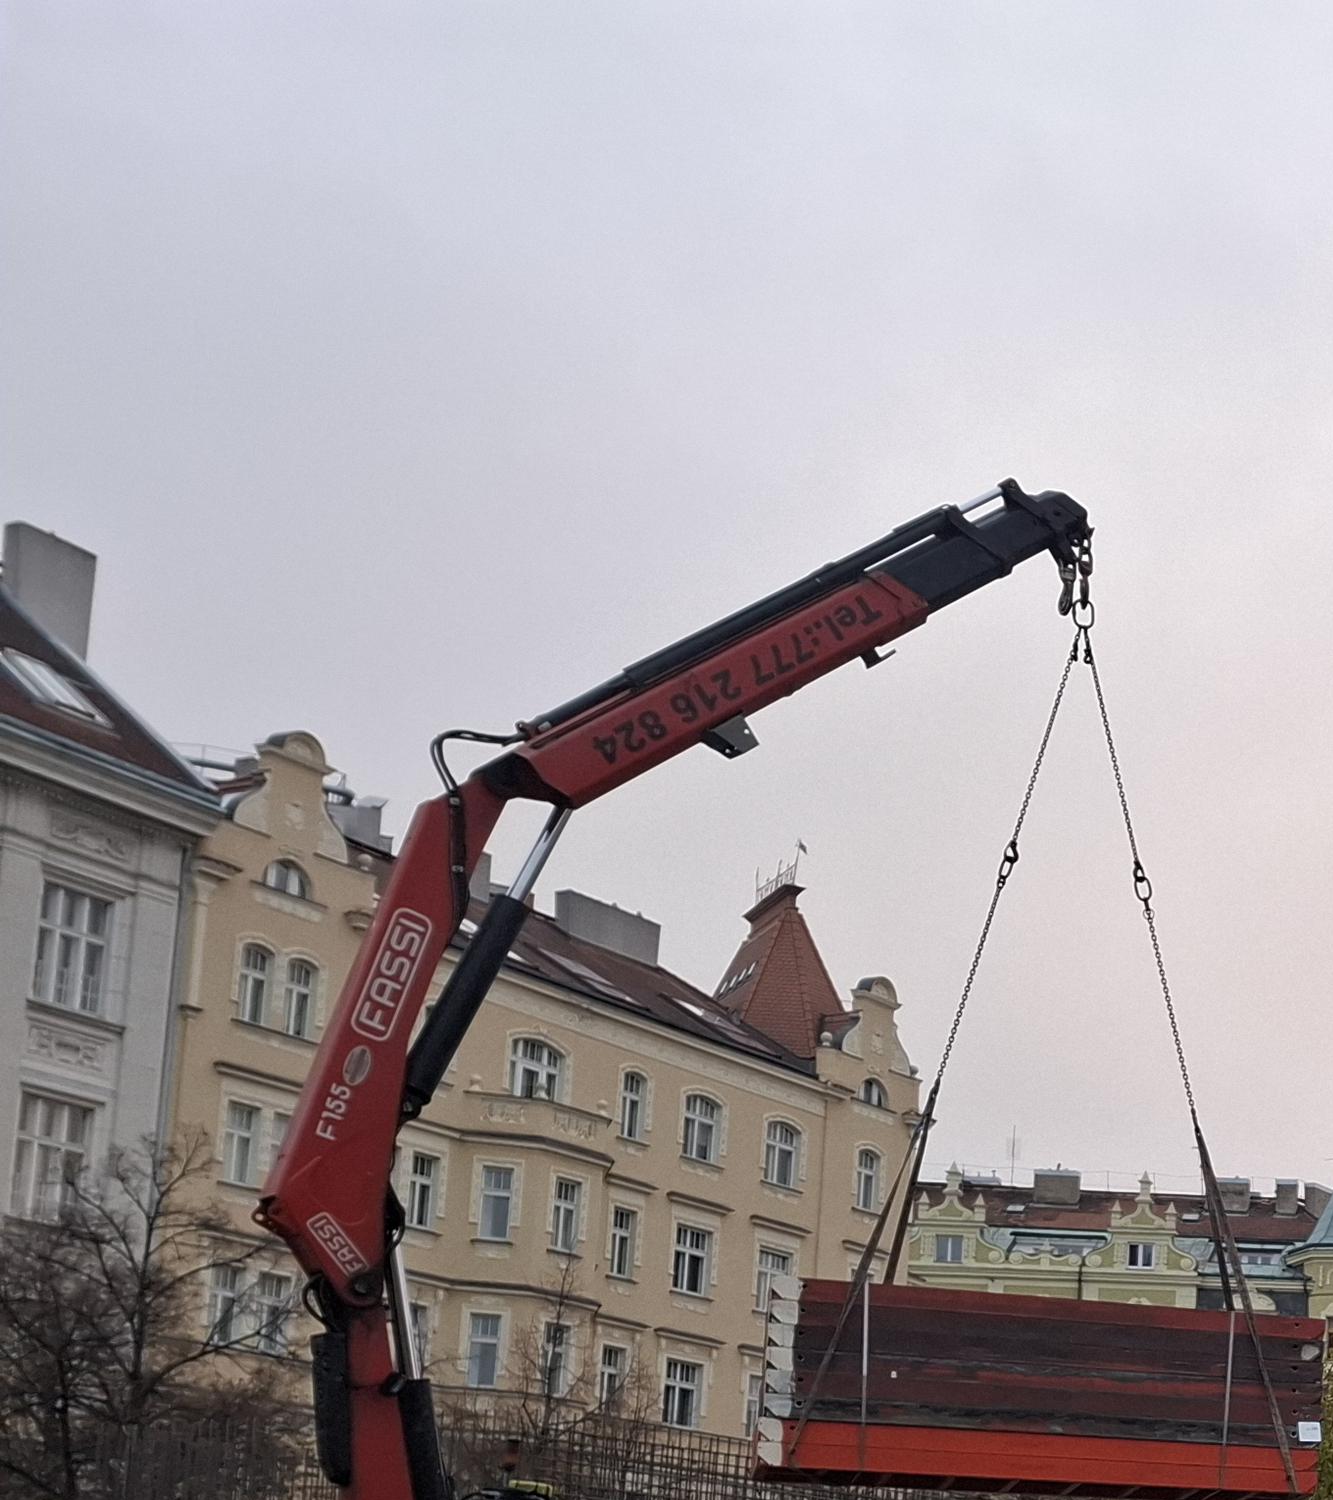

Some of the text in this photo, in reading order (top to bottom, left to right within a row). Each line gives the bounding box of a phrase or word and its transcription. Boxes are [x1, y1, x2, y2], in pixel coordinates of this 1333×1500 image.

[669, 669, 741, 723] 216
[592, 710, 667, 765] 824
[357, 916, 427, 1032] FASSI
[315, 1082, 350, 1141] F155
[313, 1218, 364, 1273] FASSI
